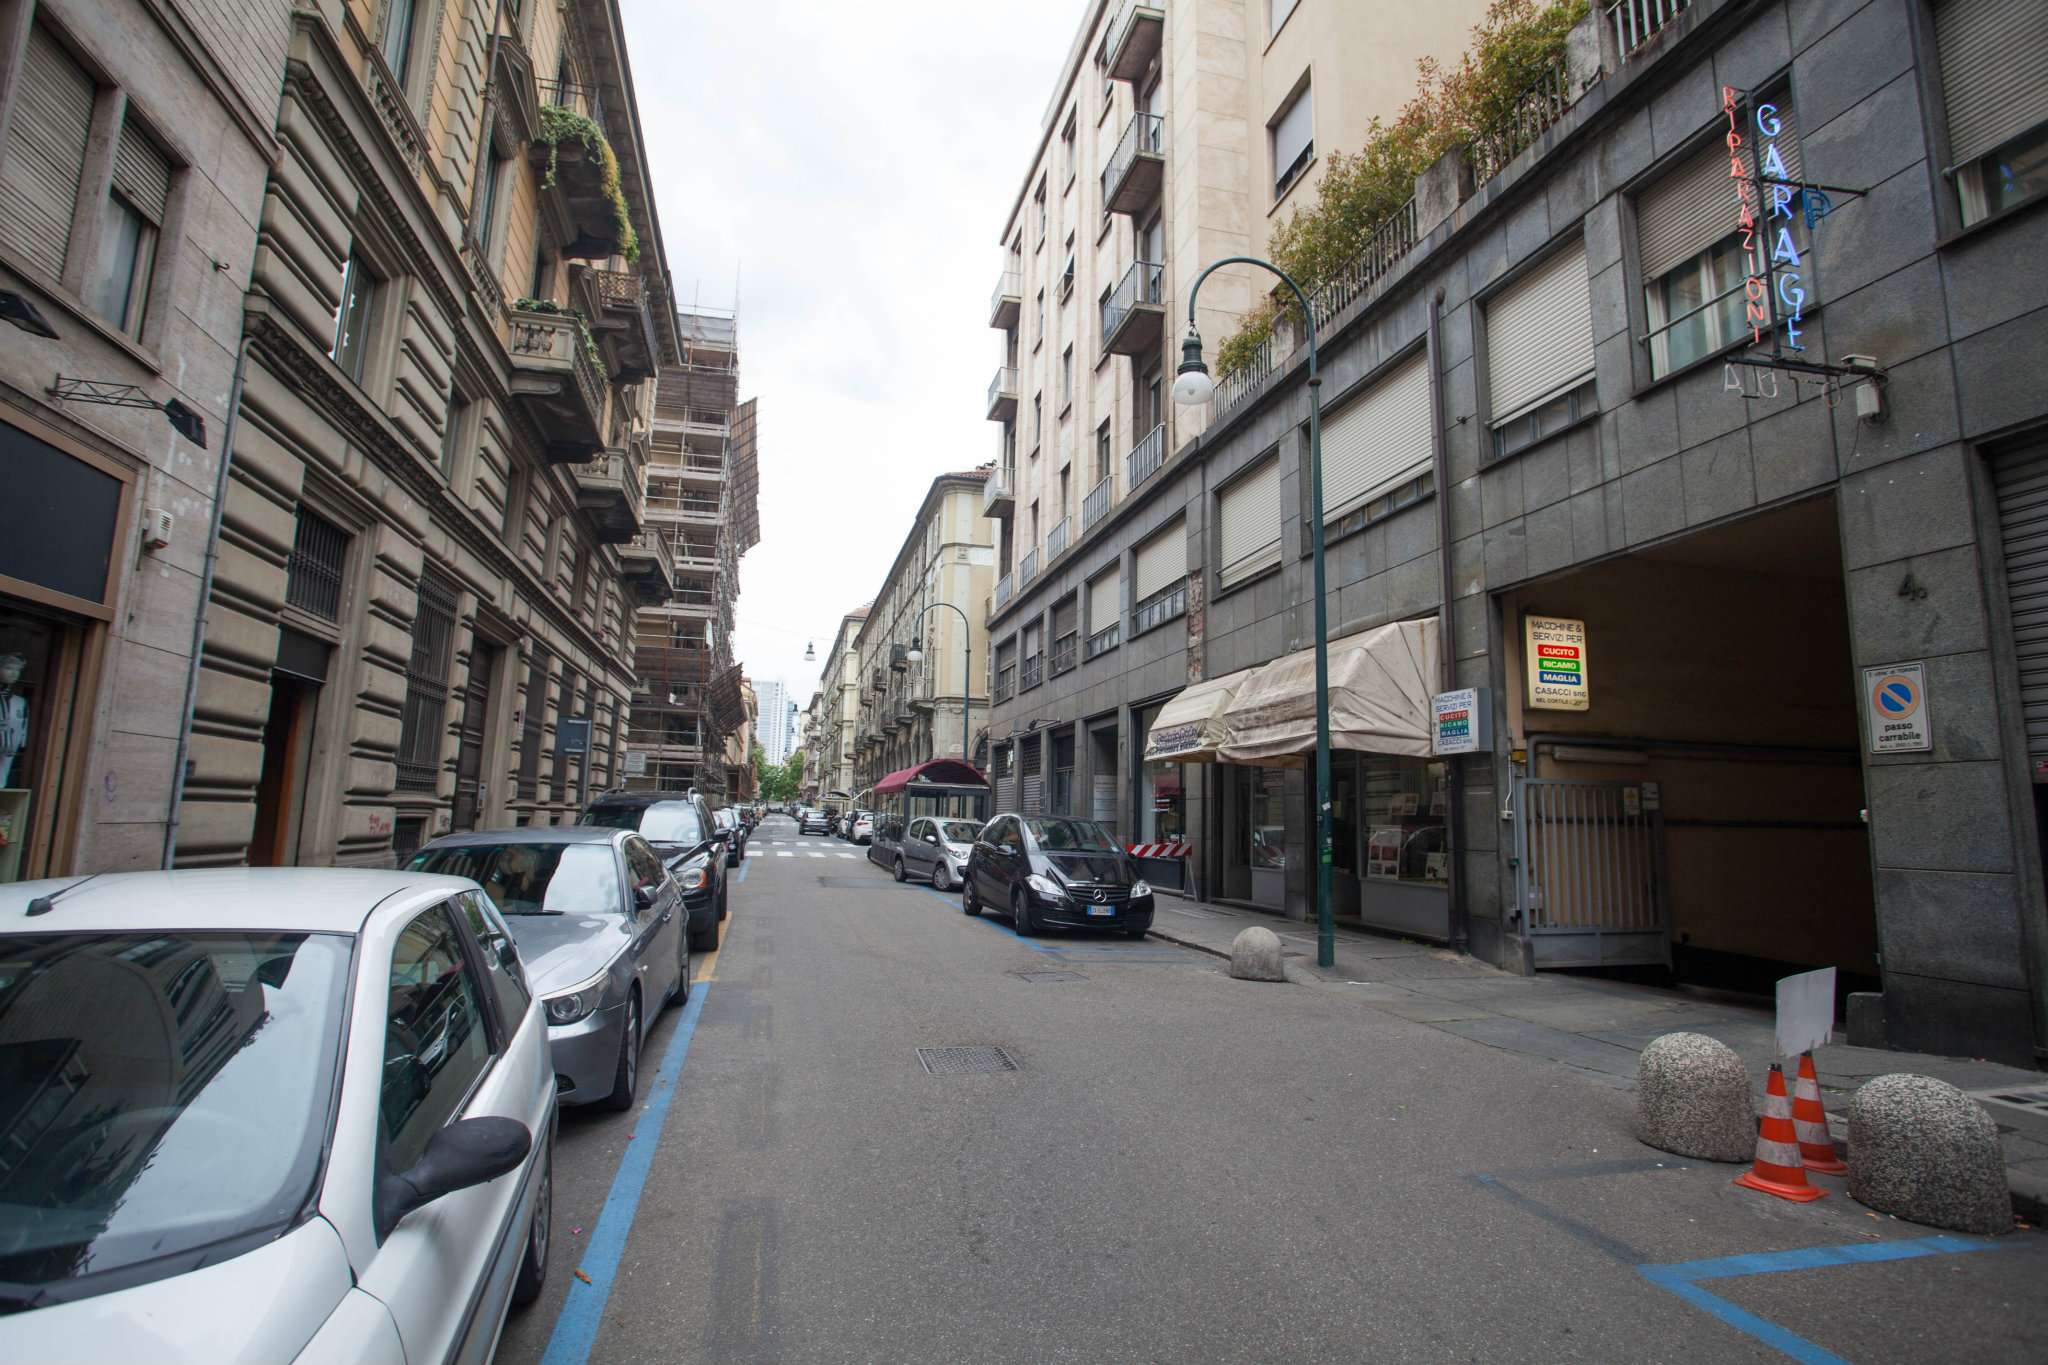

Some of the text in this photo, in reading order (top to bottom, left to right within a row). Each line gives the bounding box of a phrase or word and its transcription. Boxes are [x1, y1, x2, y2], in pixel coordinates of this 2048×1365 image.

[1723, 86, 1764, 343] RIPARAZIONI
[1757, 104, 1805, 352] GARAGE
[1532, 621, 1582, 632] MACCHINE &
[1532, 631, 1583, 644] SERVIZI PER
[1543, 647, 1575, 656] CUCITO
[1543, 660, 1577, 670] RICAMO
[1543, 673, 1578, 683] MAGLIA
[1535, 686, 1572, 697] CASACCI
[1440, 711, 1468, 721] CUCITO
[1440, 719, 1468, 729] RICAMO
[1884, 722, 1913, 732] passo
[1441, 728, 1469, 737] MAGLIA
[1879, 731, 1922, 742] carrabile
